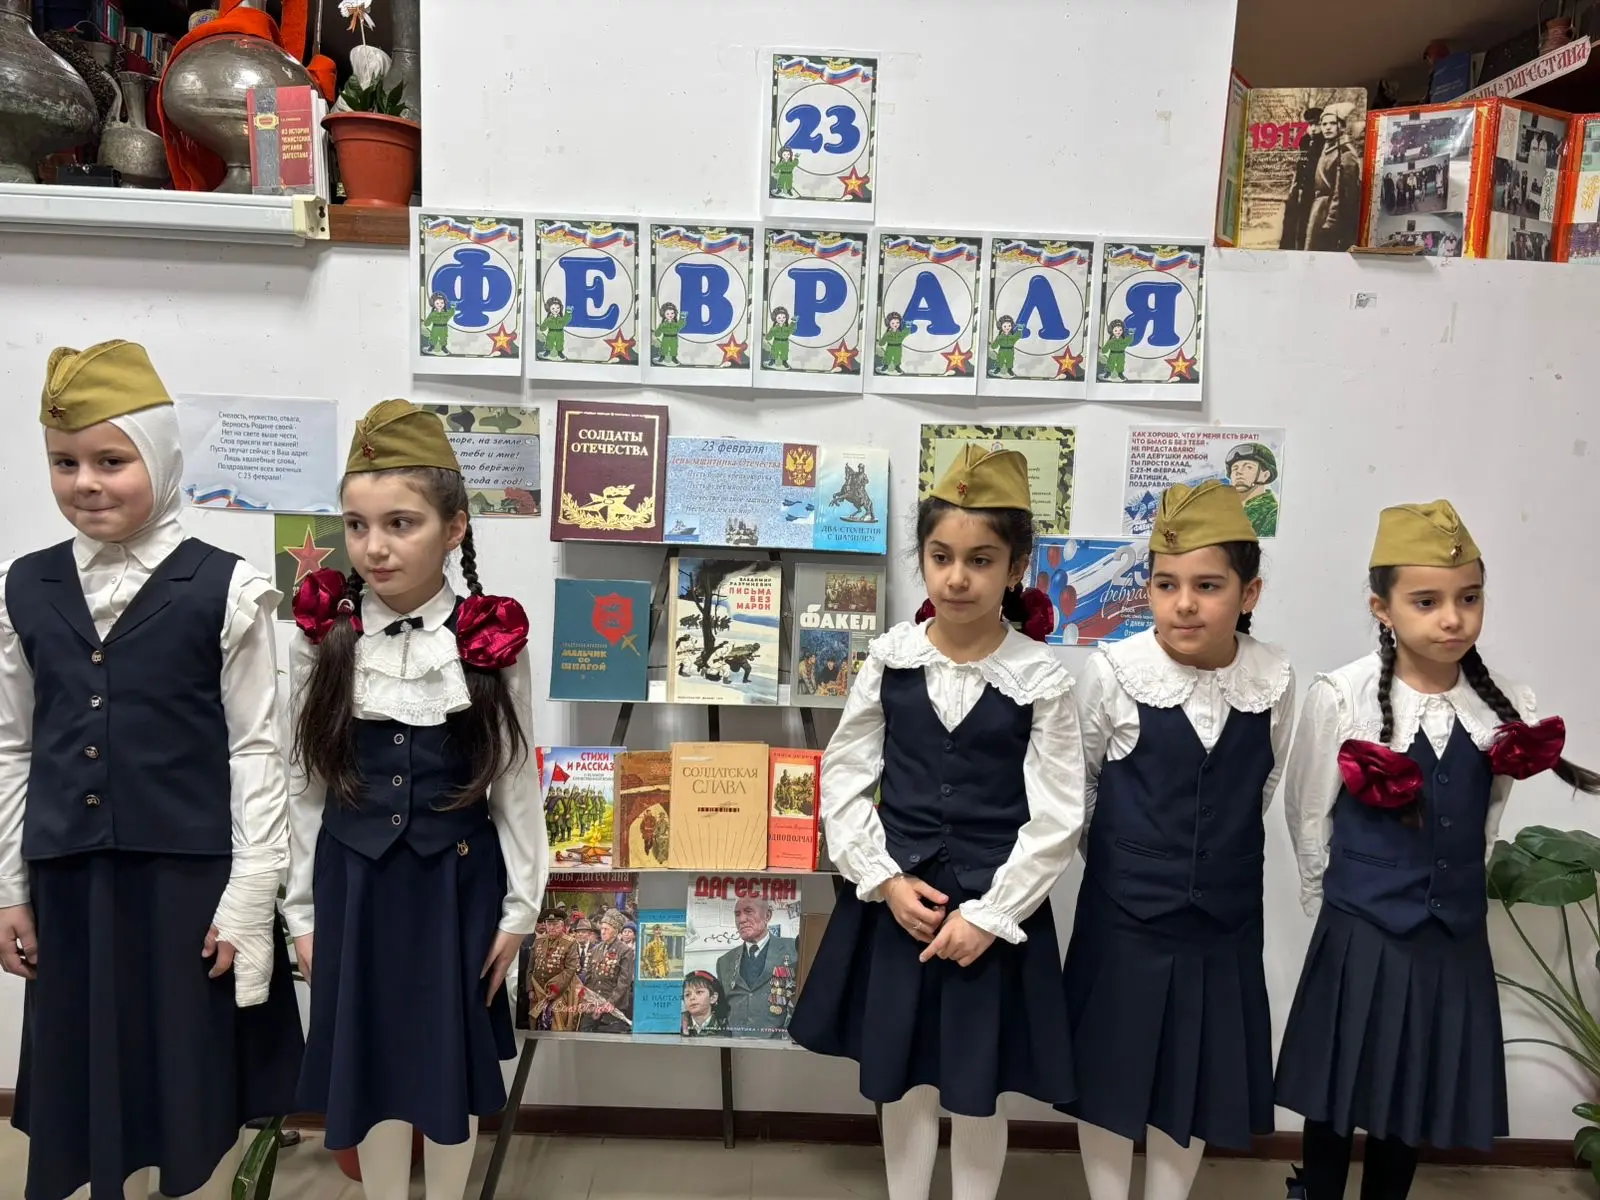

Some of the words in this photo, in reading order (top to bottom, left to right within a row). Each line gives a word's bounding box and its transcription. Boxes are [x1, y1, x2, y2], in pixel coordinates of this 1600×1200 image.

[785, 104, 861, 154] 23
[1249, 122, 1310, 152] 1917
[450, 436, 475, 446] море,
[578, 429, 644, 442] СОЛДАТЫ
[571, 442, 649, 456] ОТЕЧЕСТВА
[702, 440, 715, 452] 23
[717, 442, 764, 454] февраля
[460, 449, 486, 458] тебе
[496, 452, 520, 460] мне!
[468, 476, 490, 485] года
[501, 478, 523, 486] год!
[729, 587, 772, 596] ПИСЬМА
[800, 604, 877, 630] ФАКЕЛ
[562, 662, 606, 672] ШПАГОЙ
[580, 752, 609, 761] СТИХИ
[567, 762, 574, 770] И
[576, 762, 615, 772] РАССКАЗ
[682, 767, 758, 778] СОЛДАТСКАЯ
[692, 779, 747, 794] СЛАВА
[694, 876, 797, 900] ДАГЕСТАН
